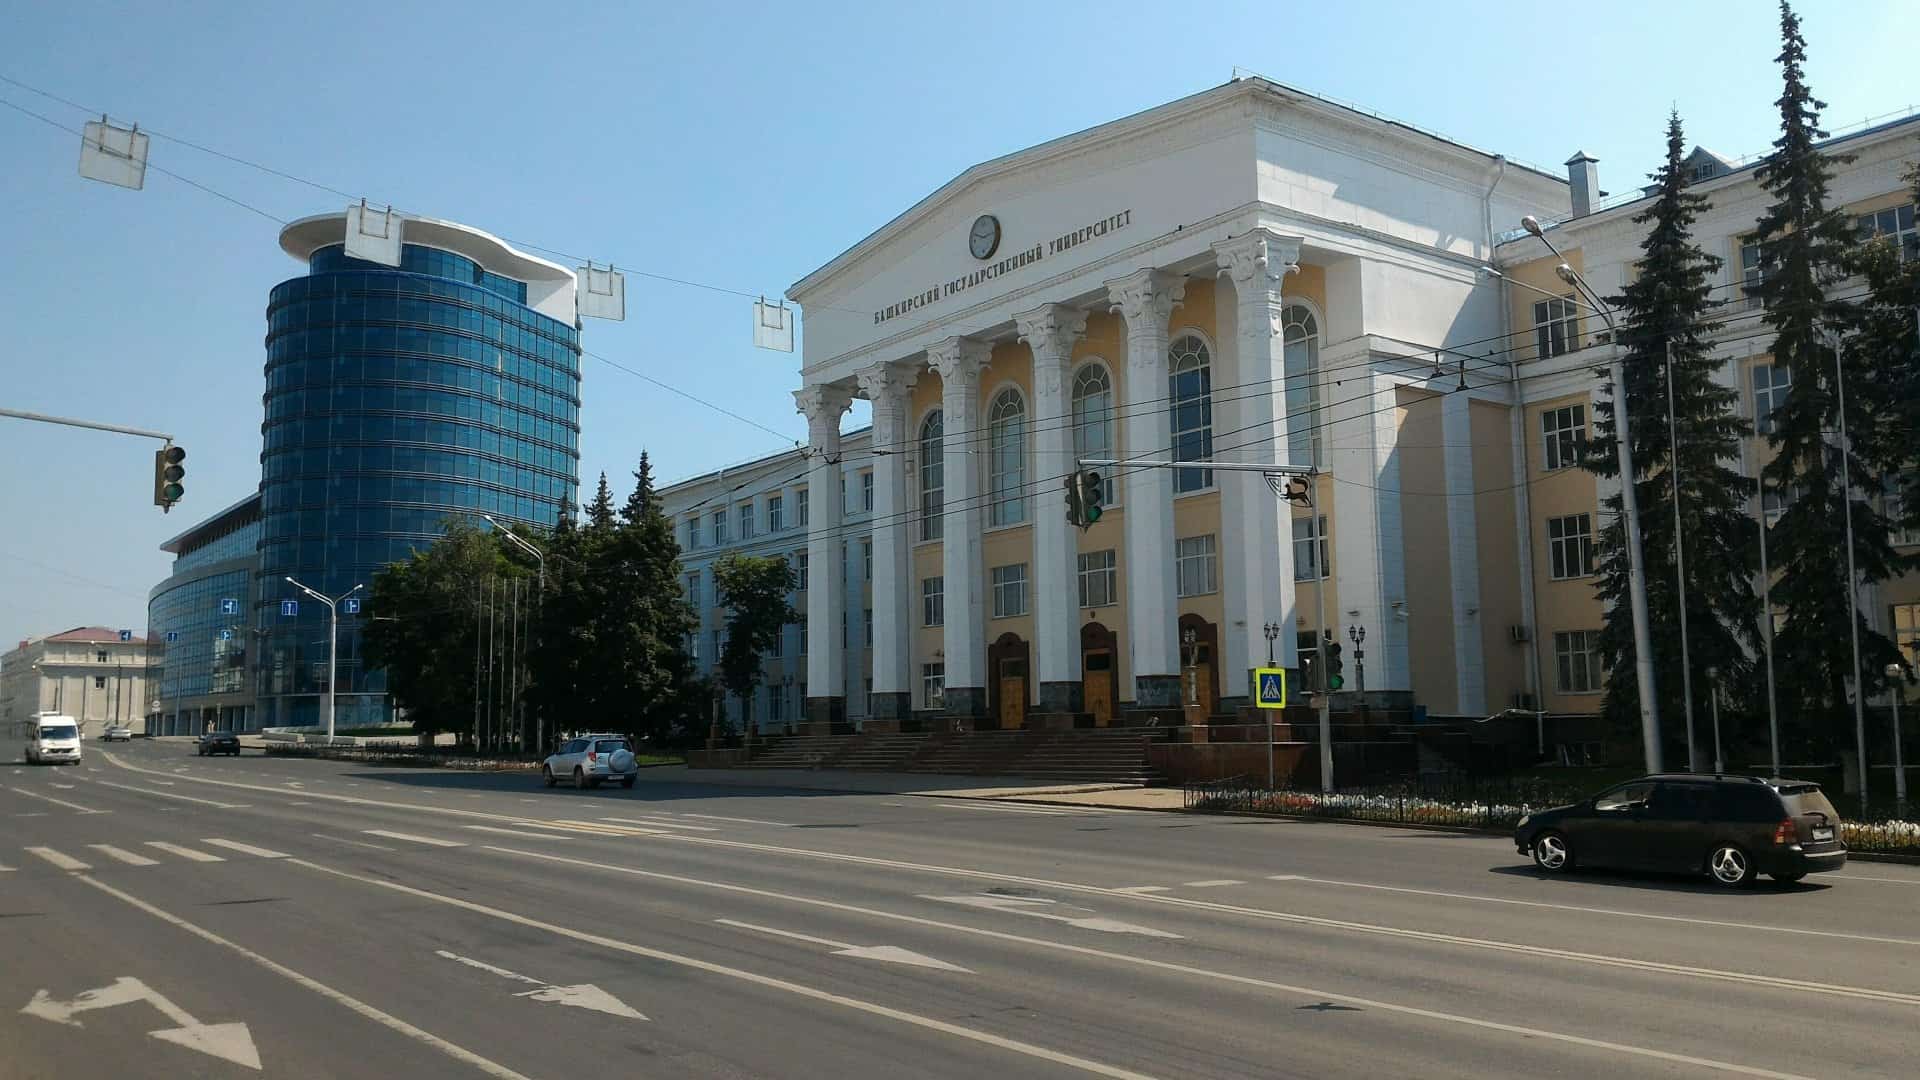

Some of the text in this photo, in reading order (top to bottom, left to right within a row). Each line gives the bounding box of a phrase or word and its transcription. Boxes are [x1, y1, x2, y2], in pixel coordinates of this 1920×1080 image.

[874, 209, 1131, 325] БАШКИРСКИЙ ГОСУДАРСТВЕННЫЙ УНИВЕРСИТЕТ
